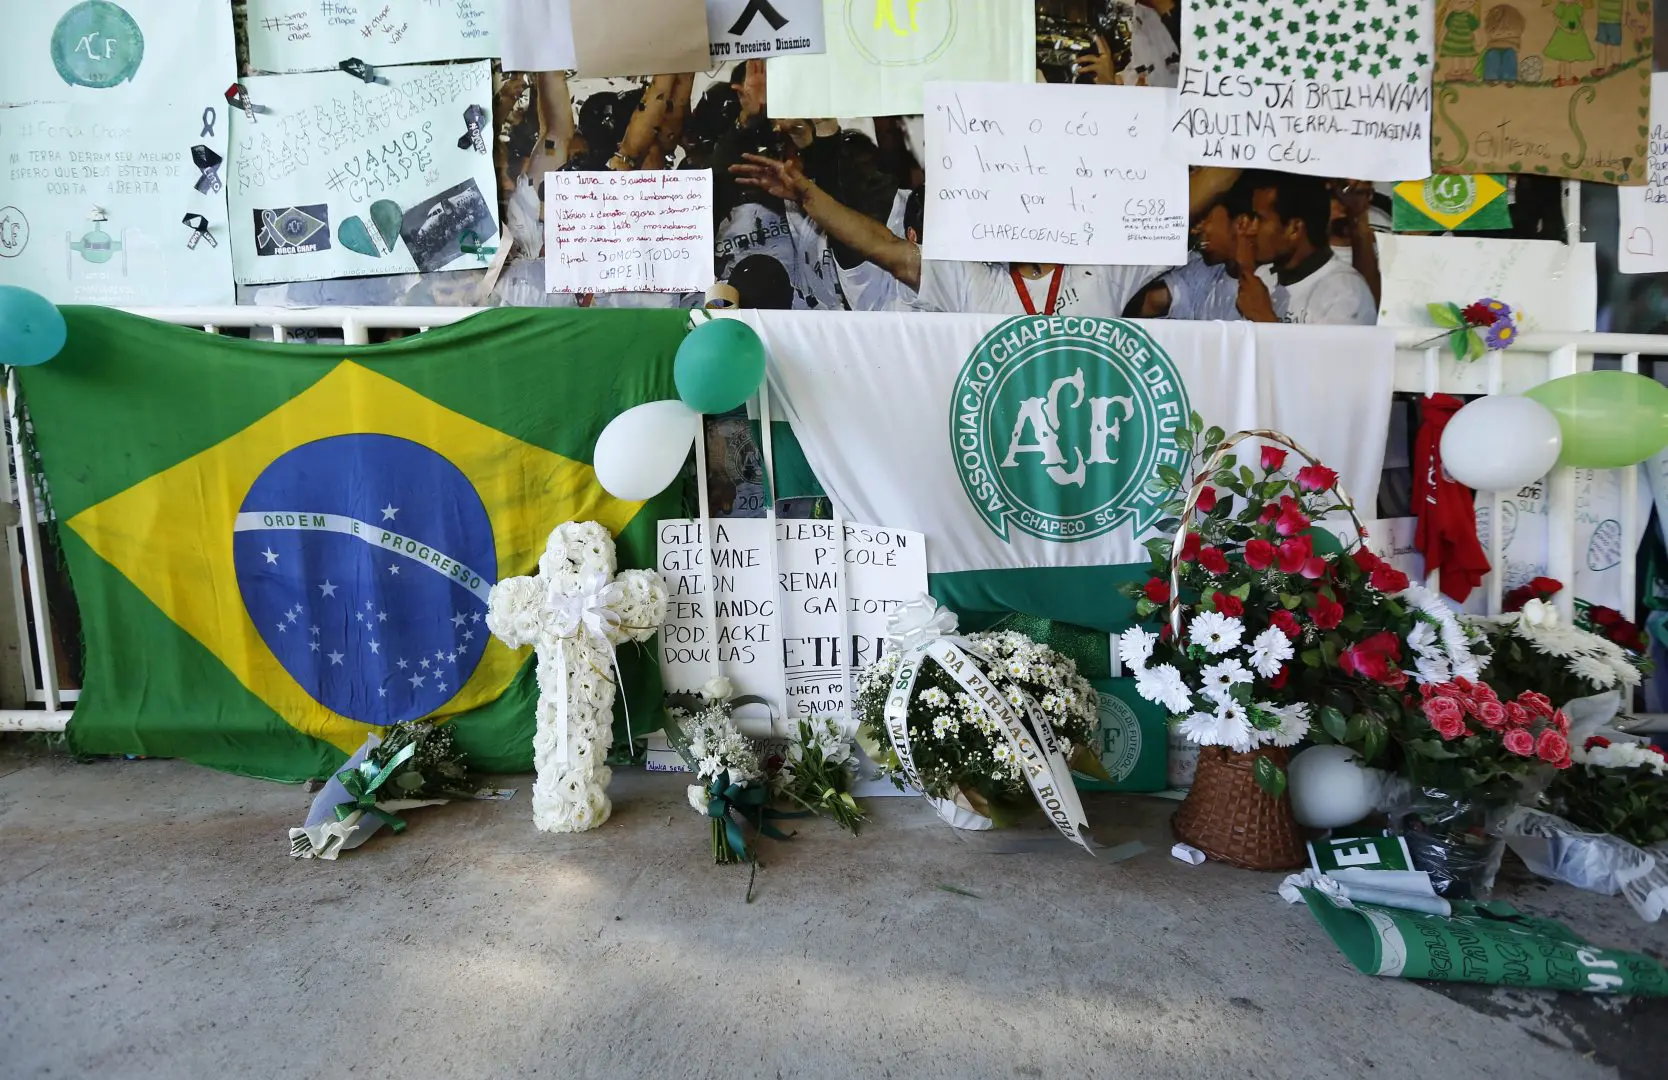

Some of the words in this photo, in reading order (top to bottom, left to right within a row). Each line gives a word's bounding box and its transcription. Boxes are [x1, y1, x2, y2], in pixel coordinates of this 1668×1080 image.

[709, 41, 731, 56] LUTO
[734, 41, 771, 54] Terceirão
[775, 37, 811, 51] Dinâmico
[1180, 67, 1253, 97] ELES
[1265, 79, 1296, 109] JÁ
[1305, 82, 1429, 113] BRILHAVAM
[1351, 119, 1422, 142] IMAGINA
[1202, 137, 1223, 158] LÁ
[1231, 144, 1255, 161] NO
[54, 167, 78, 179] QUE
[974, 145, 1048, 175] limite
[1103, 167, 1147, 180] meu
[47, 182, 87, 195] PORTA
[107, 181, 160, 195] ABERTA
[938, 187, 991, 201] amor
[1020, 192, 1045, 214] por
[972, 223, 1078, 246] CHAPECOENSE
[597, 250, 642, 263] SOMOS
[645, 248, 690, 261] TODOS
[959, 361, 1006, 514] ASSOCIAÇÃO
[990, 317, 1152, 369] CHAPECOENSE
[1142, 364, 1173, 399] DE
[1094, 508, 1116, 526] SC
[264, 514, 326, 528] ORDEM
[353, 522, 360, 534] E
[380, 532, 482, 590] PROGRESSO
[664, 624, 770, 644] PODACKI
[943, 650, 966, 675] DA
[966, 674, 1044, 780] FARMACIA
[1037, 784, 1076, 839] ROCHA
